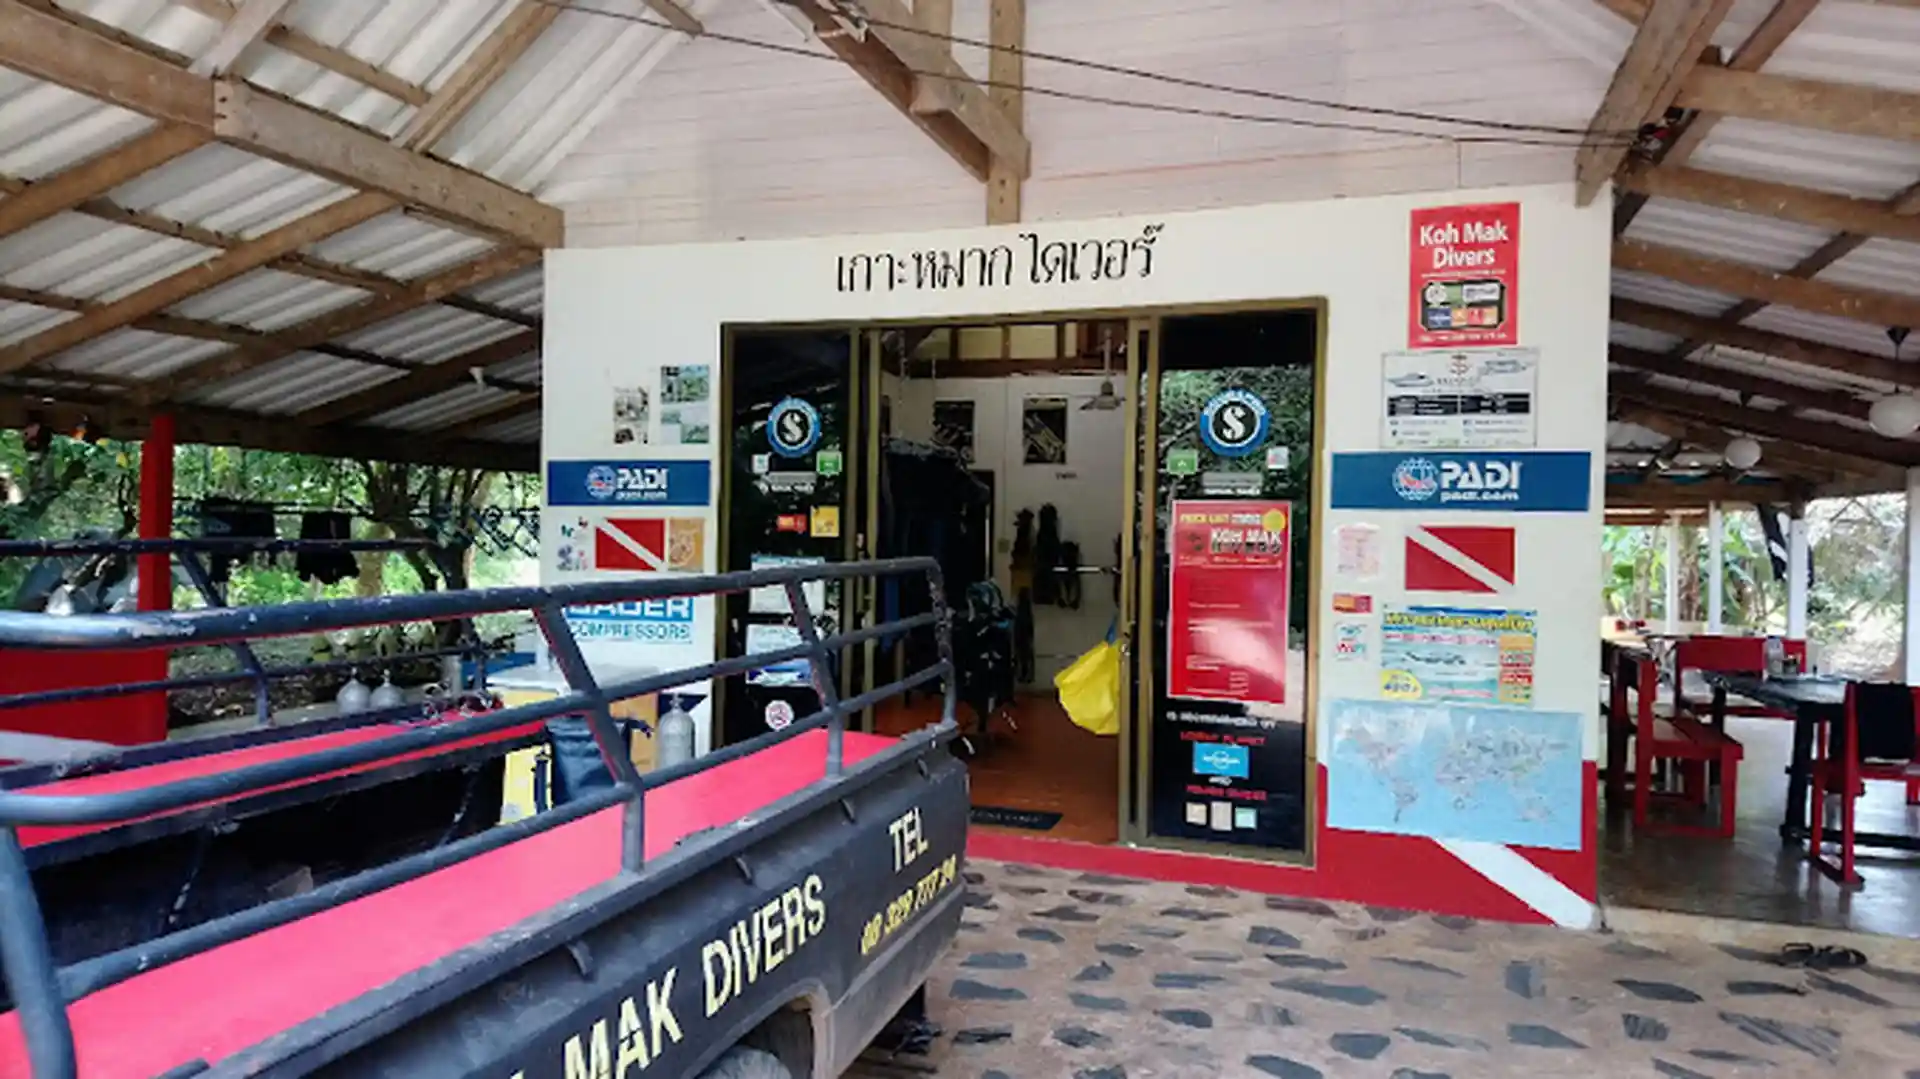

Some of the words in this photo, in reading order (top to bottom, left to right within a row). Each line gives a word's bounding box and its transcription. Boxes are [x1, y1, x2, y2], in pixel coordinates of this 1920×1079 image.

[1420, 221, 1460, 246] Koh
[1463, 219, 1509, 243] Mak
[837, 244, 1014, 292] เกาะหมาก
[1433, 246, 1496, 269] Divers
[616, 468, 668, 489] PADI
[1441, 461, 1521, 489] PADI
[1441, 491, 1519, 502] padi.com
[889, 806, 928, 873] TEL
[564, 966, 684, 1079] MAK
[702, 874, 827, 1018] DIVERS
